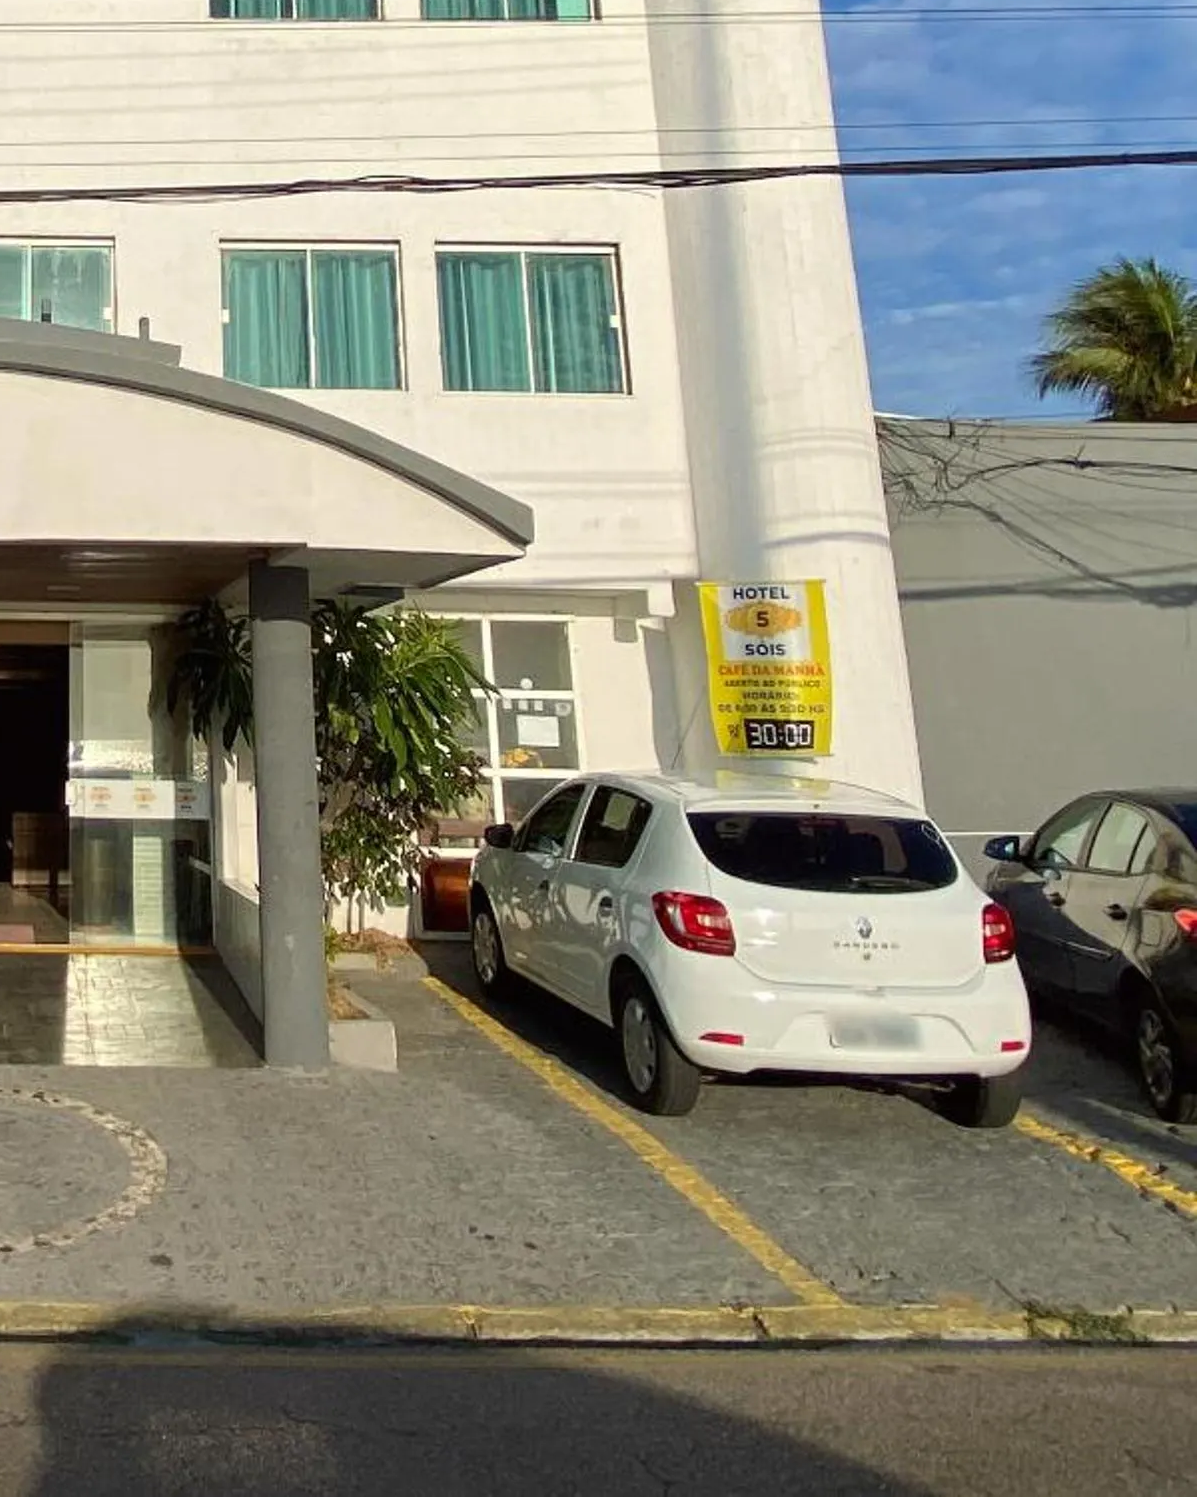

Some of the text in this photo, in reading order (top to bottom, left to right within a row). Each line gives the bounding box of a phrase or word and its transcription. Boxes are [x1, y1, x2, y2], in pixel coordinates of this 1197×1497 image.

[733, 586, 790, 600] HOTEL
[757, 610, 769, 627] 5
[748, 723, 812, 747] 30:00
